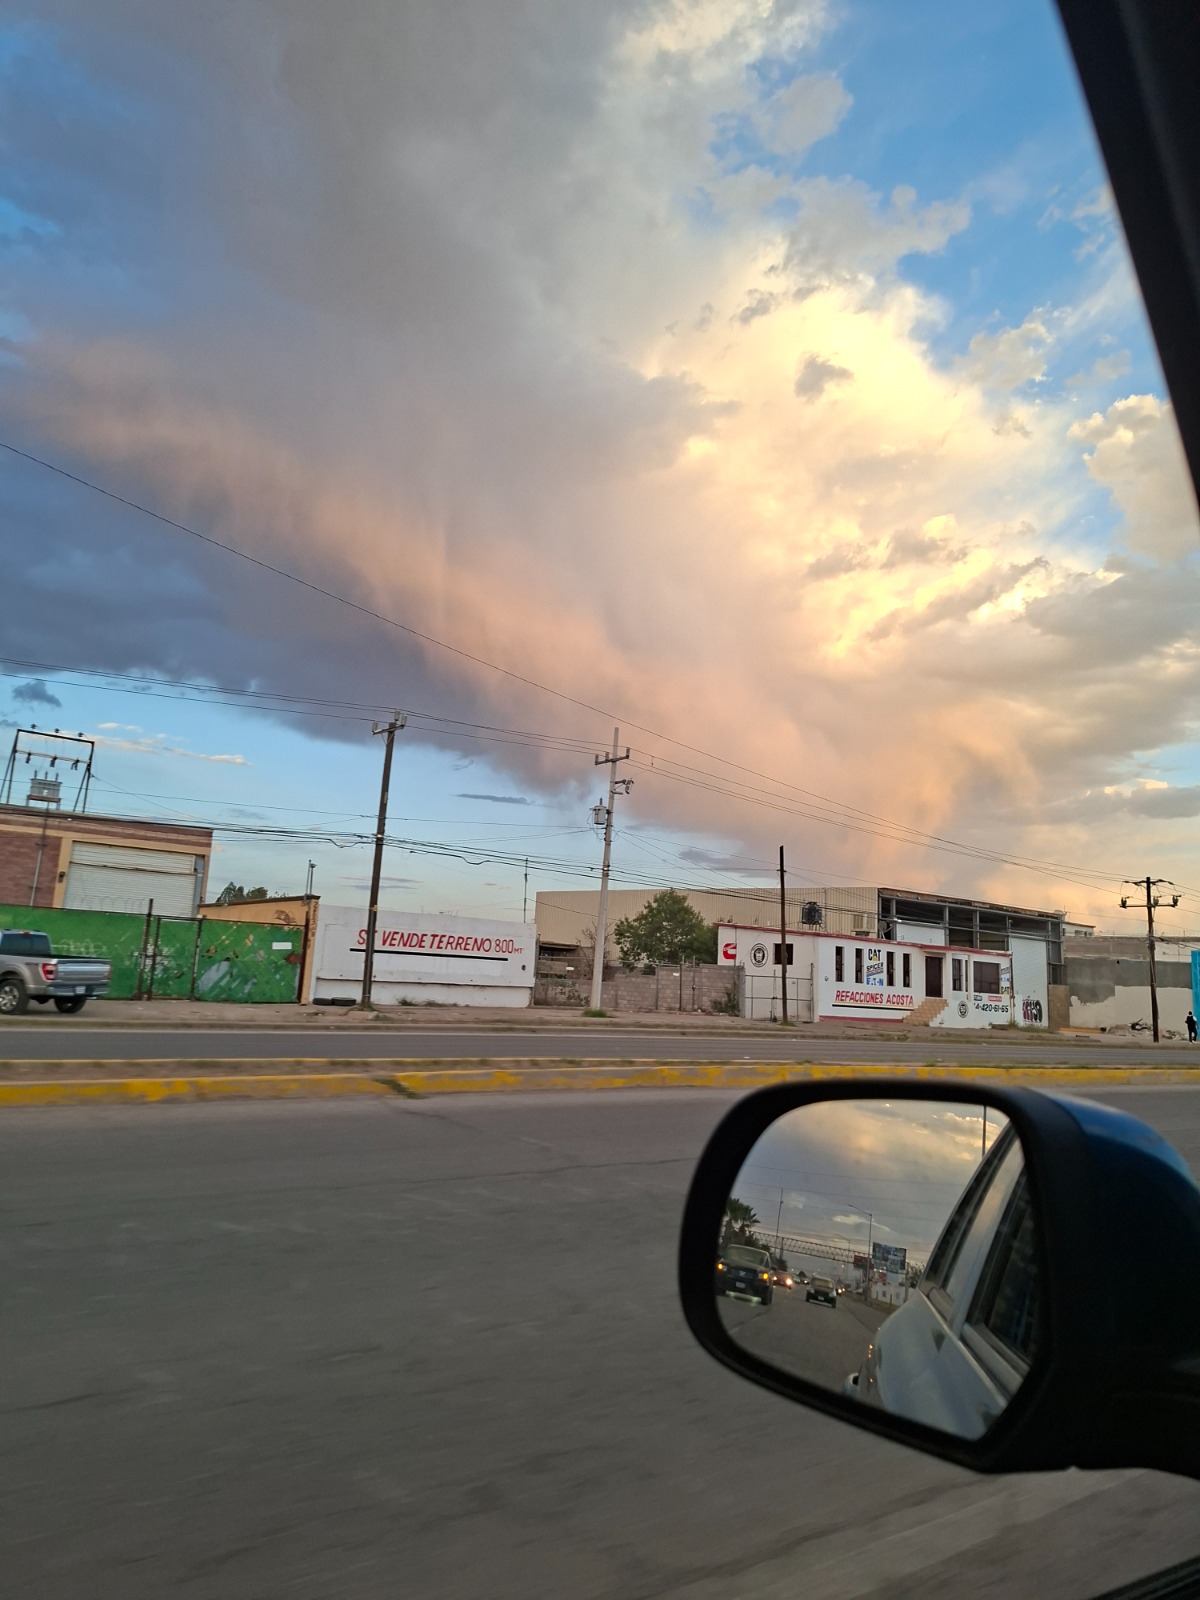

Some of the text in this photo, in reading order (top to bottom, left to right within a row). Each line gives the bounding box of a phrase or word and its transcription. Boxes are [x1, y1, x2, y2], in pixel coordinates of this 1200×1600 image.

[381, 930, 427, 949] VENDE
[430, 934, 492, 953] TERRENO
[494, 939, 514, 954] 800
[868, 948, 882, 962] CAT
[835, 990, 914, 1006] REFACCIONES ACOSTA
[973, 1003, 1009, 1013] 4-420-61-65
